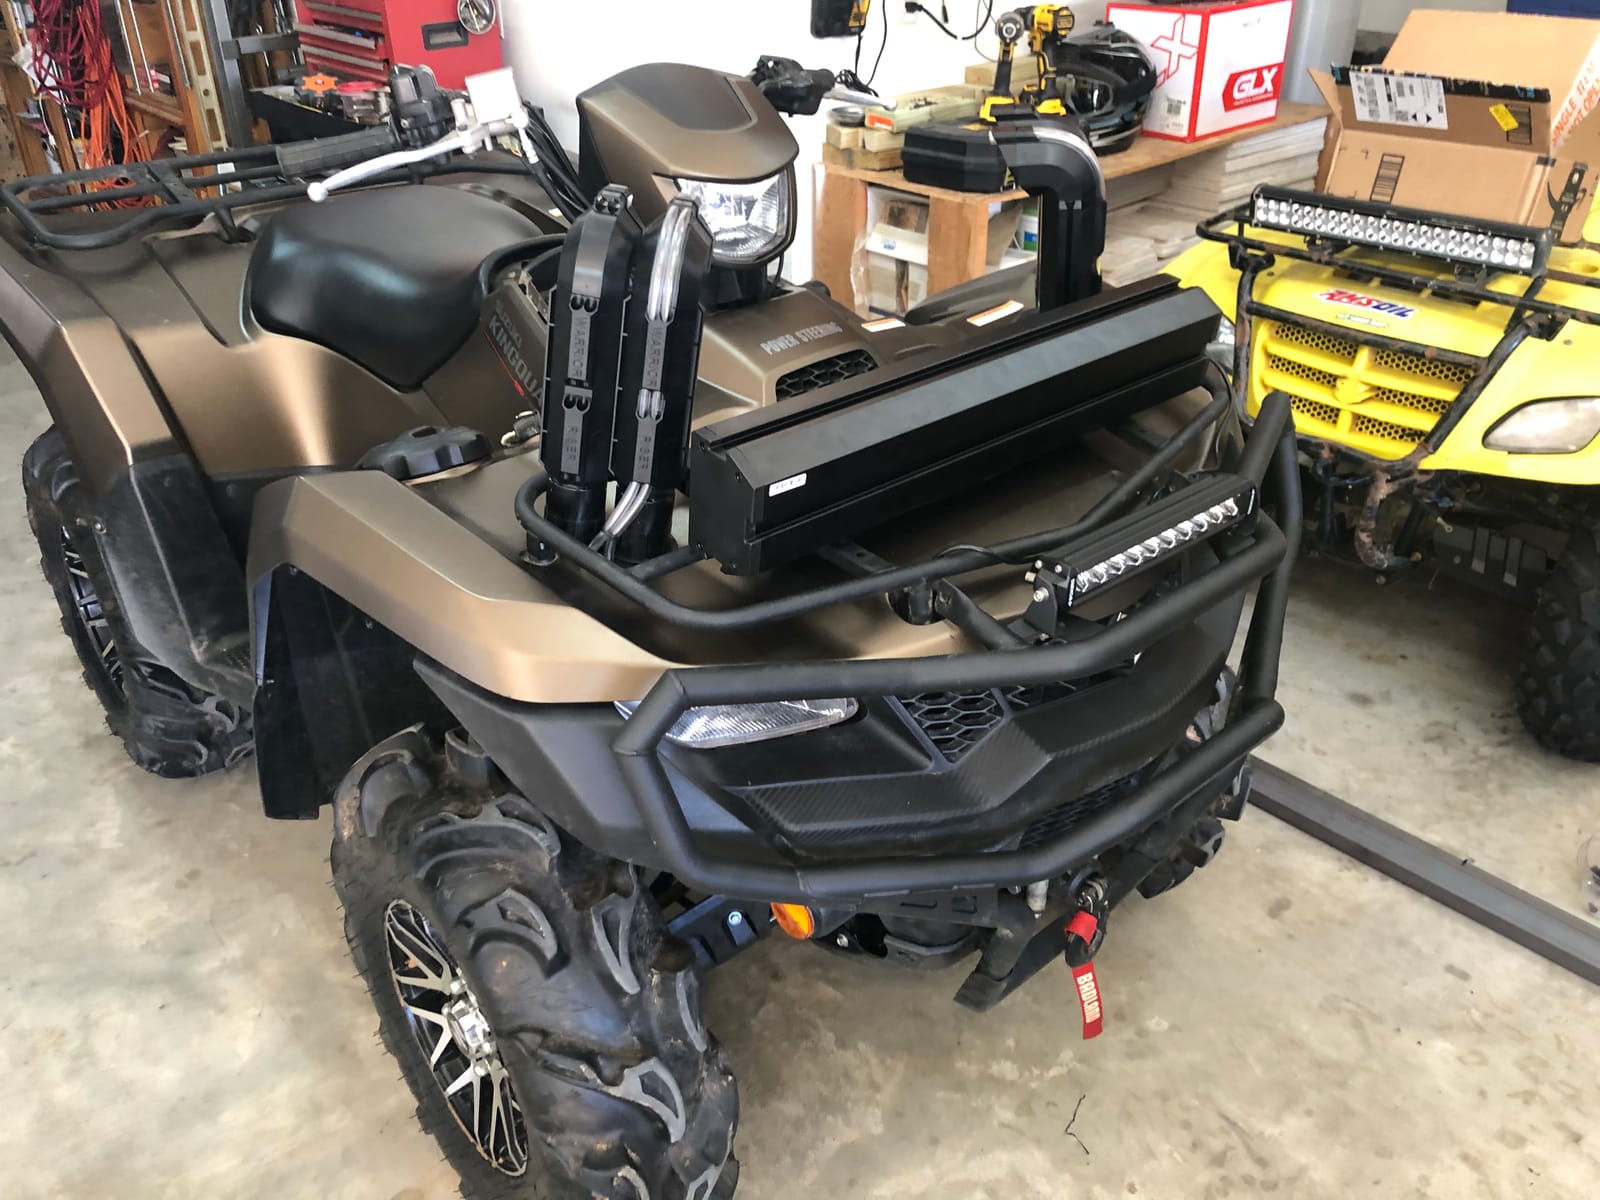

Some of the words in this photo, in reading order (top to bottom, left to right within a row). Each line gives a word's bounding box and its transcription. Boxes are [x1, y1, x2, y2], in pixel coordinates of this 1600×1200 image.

[1233, 66, 1279, 100] GLX
[1319, 288, 1415, 318] AMSOIL
[489, 314, 543, 407] KINGQUA
[570, 314, 588, 378] WARRIOR
[760, 334, 800, 356] POWER
[795, 321, 843, 343] STEERING
[1076, 971, 1101, 1024] BADLAND
